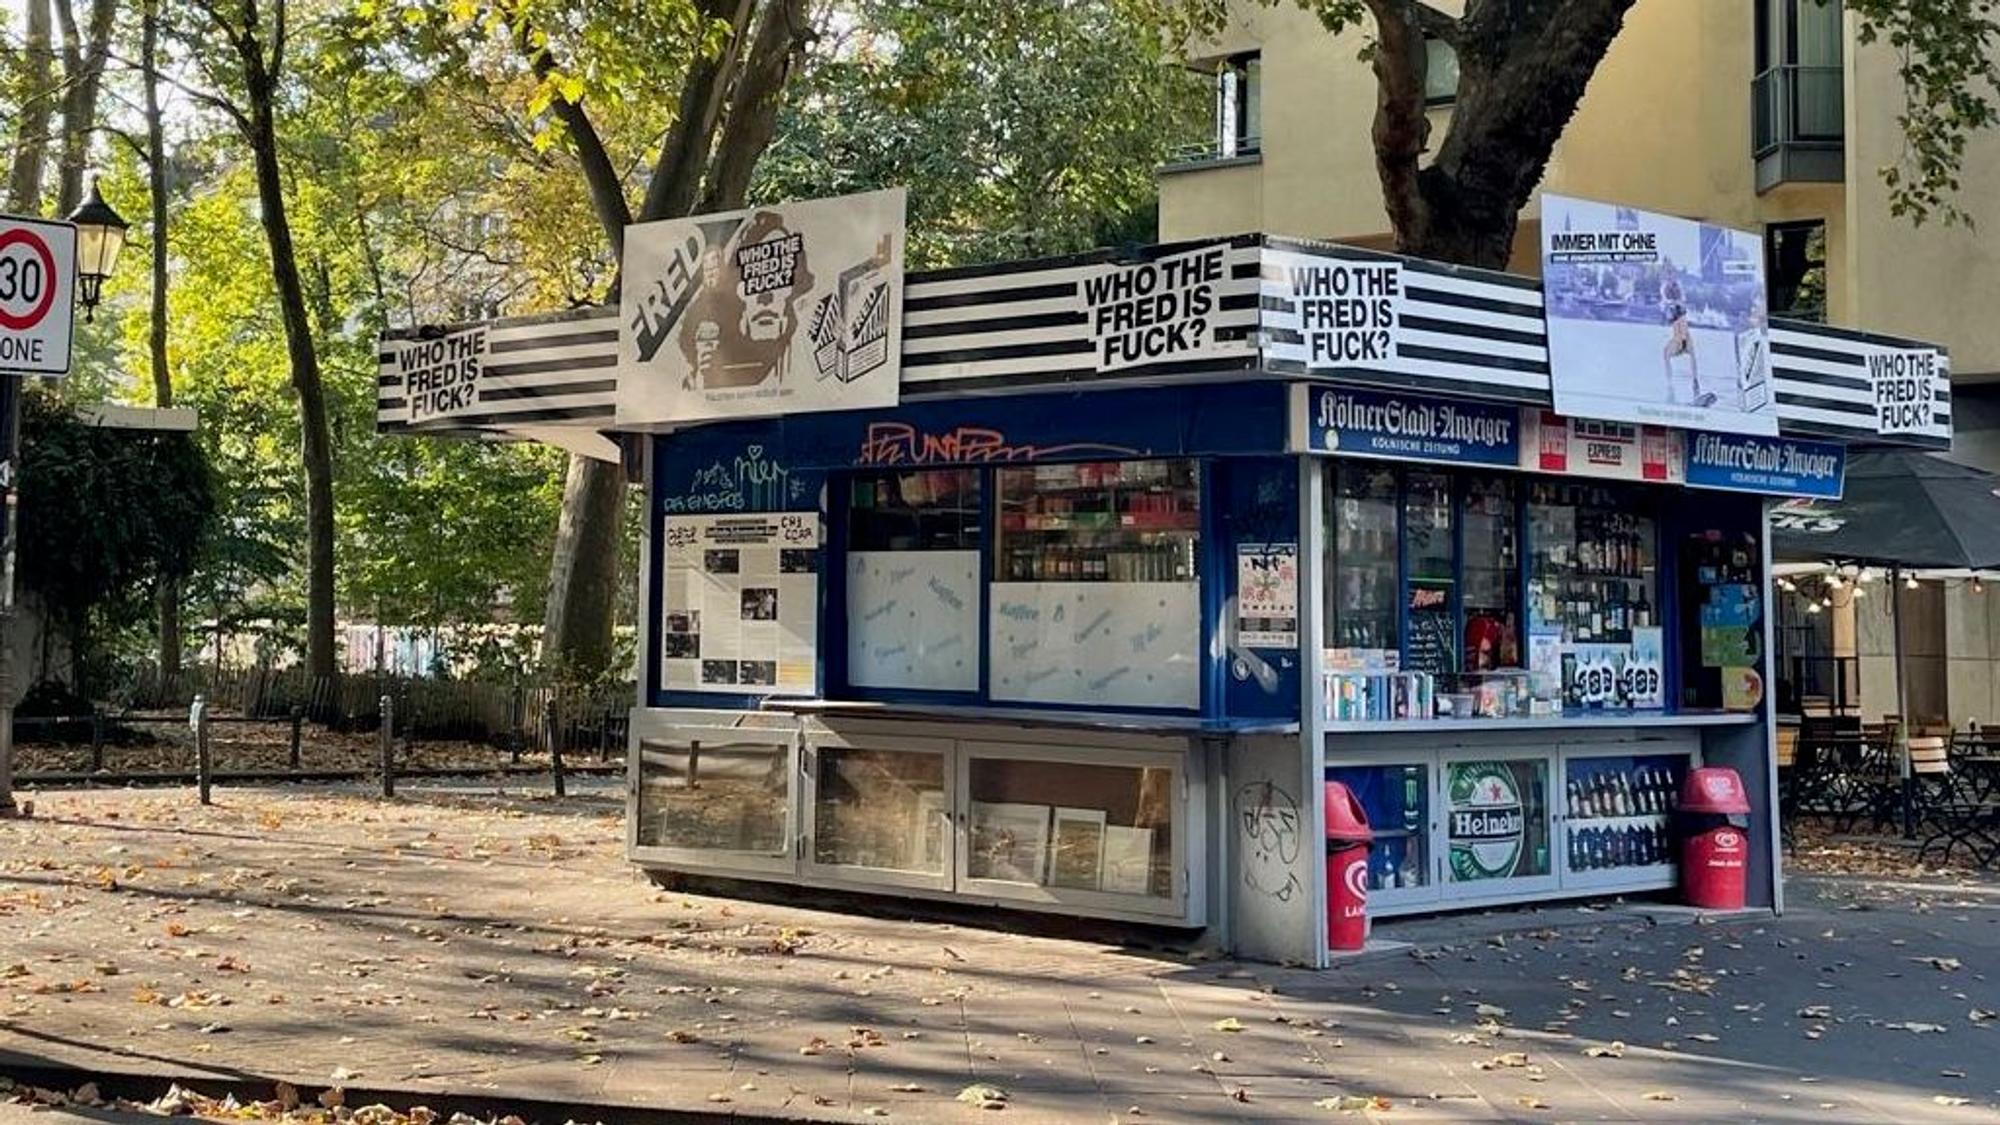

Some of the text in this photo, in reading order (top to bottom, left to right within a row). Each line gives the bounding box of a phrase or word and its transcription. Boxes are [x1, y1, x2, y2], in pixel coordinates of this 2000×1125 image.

[739, 236, 800, 265] WHO THE
[1551, 233, 1656, 250] IMMER MIT OHNE
[0, 256, 40, 302] 30
[744, 254, 795, 279] FRED IS
[1085, 250, 1223, 306] WHO THE
[1290, 267, 1398, 296] WHO THE
[631, 223, 706, 352] FRED
[747, 270, 792, 294] FUCK?
[1096, 285, 1212, 336] FRED IS
[1302, 299, 1392, 329] FRED IS
[0, 337, 43, 362] ONE
[400, 331, 485, 372] WHO THE
[1104, 318, 1206, 366] FUCK?
[1312, 331, 1390, 361] FUCK?
[407, 357, 478, 395] FRED IS
[1869, 353, 1934, 378] WHO THE
[412, 383, 474, 419] FUCK?
[1877, 379, 1931, 404] FRED IS
[1882, 404, 1929, 430] FUCK?
